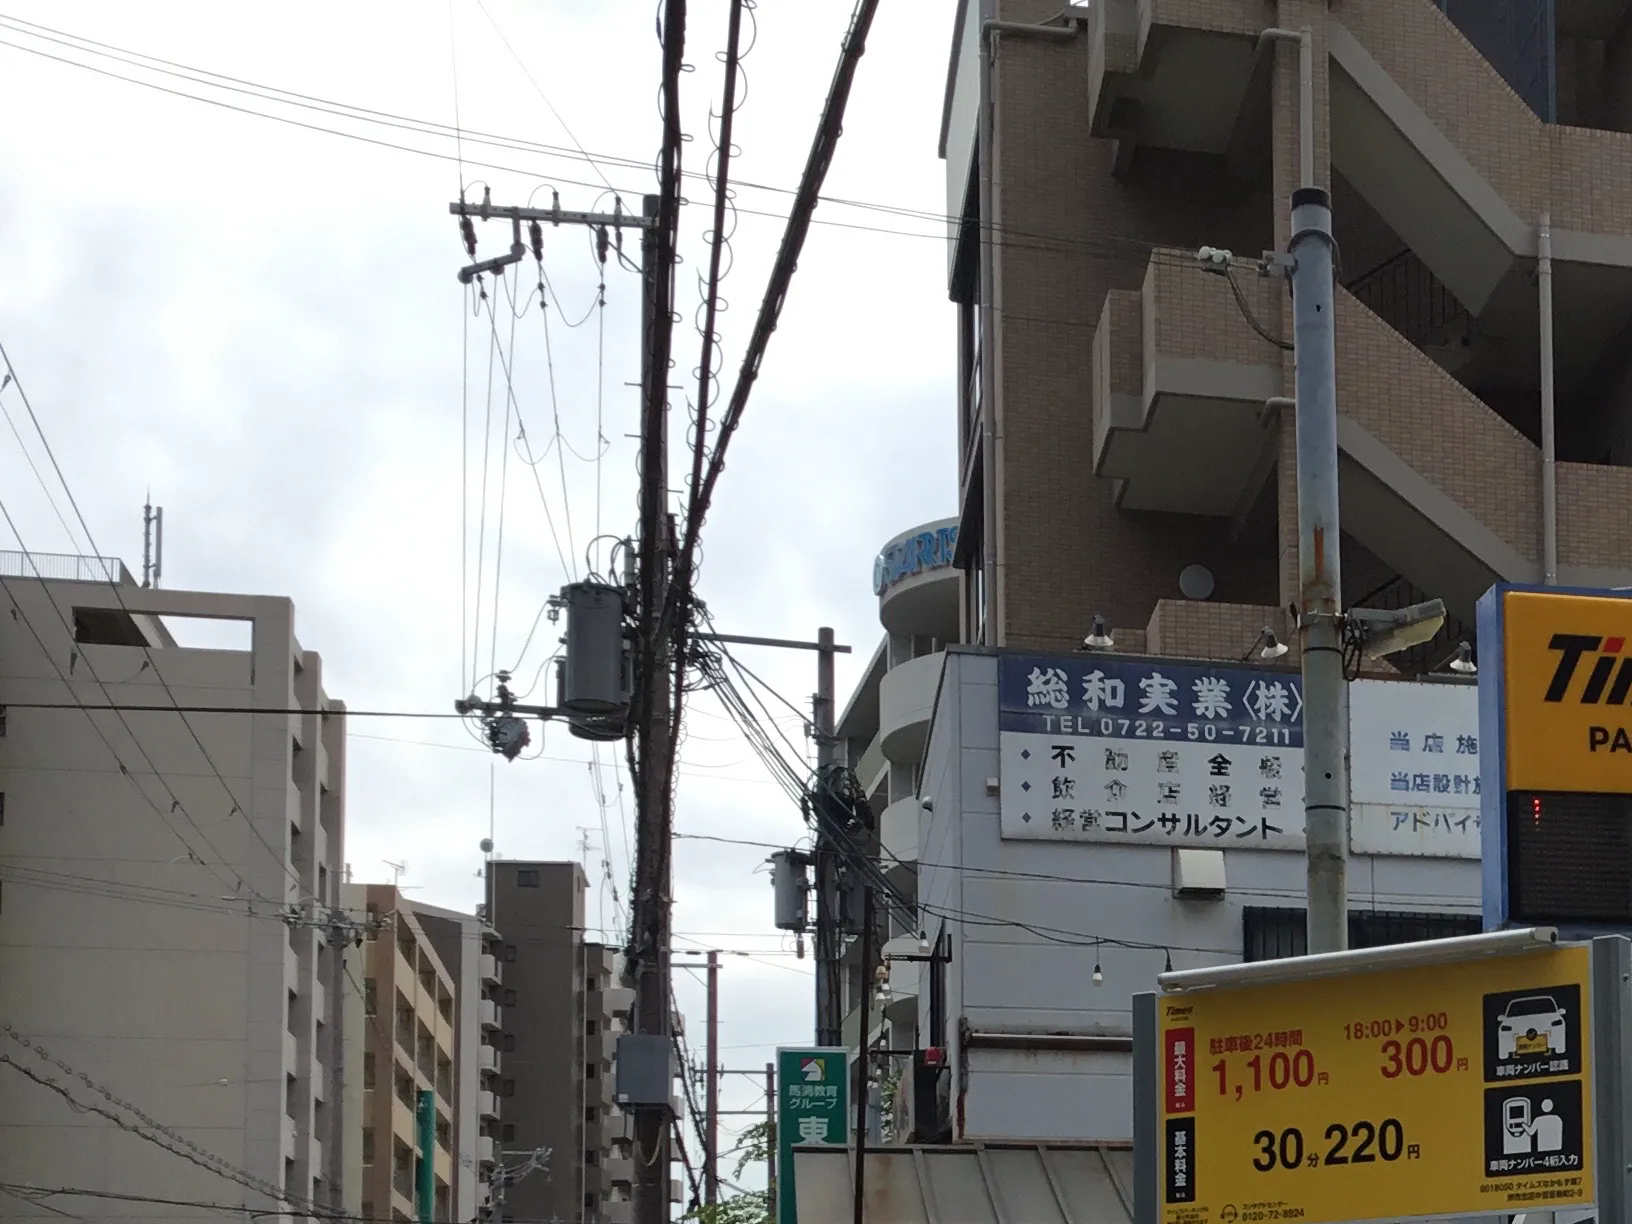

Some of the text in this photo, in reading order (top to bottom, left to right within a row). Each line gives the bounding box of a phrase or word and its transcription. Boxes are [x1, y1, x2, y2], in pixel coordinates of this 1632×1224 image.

[1042, 715, 1291, 744] TEL 0722-50-7211
[1051, 807, 1284, 840] 経営コンサルタント
[1344, 1012, 1448, 1040] 18:00 9:00
[1210, 1028, 1303, 1056] 駐車後24時間
[1380, 1034, 1469, 1078] 300円
[789, 1098, 838, 1109] グループ
[798, 1116, 829, 1145] 東
[1174, 1131, 1187, 1187] 基本料金
[1489, 1154, 1578, 1172] 車両ナンバー4桁入力
